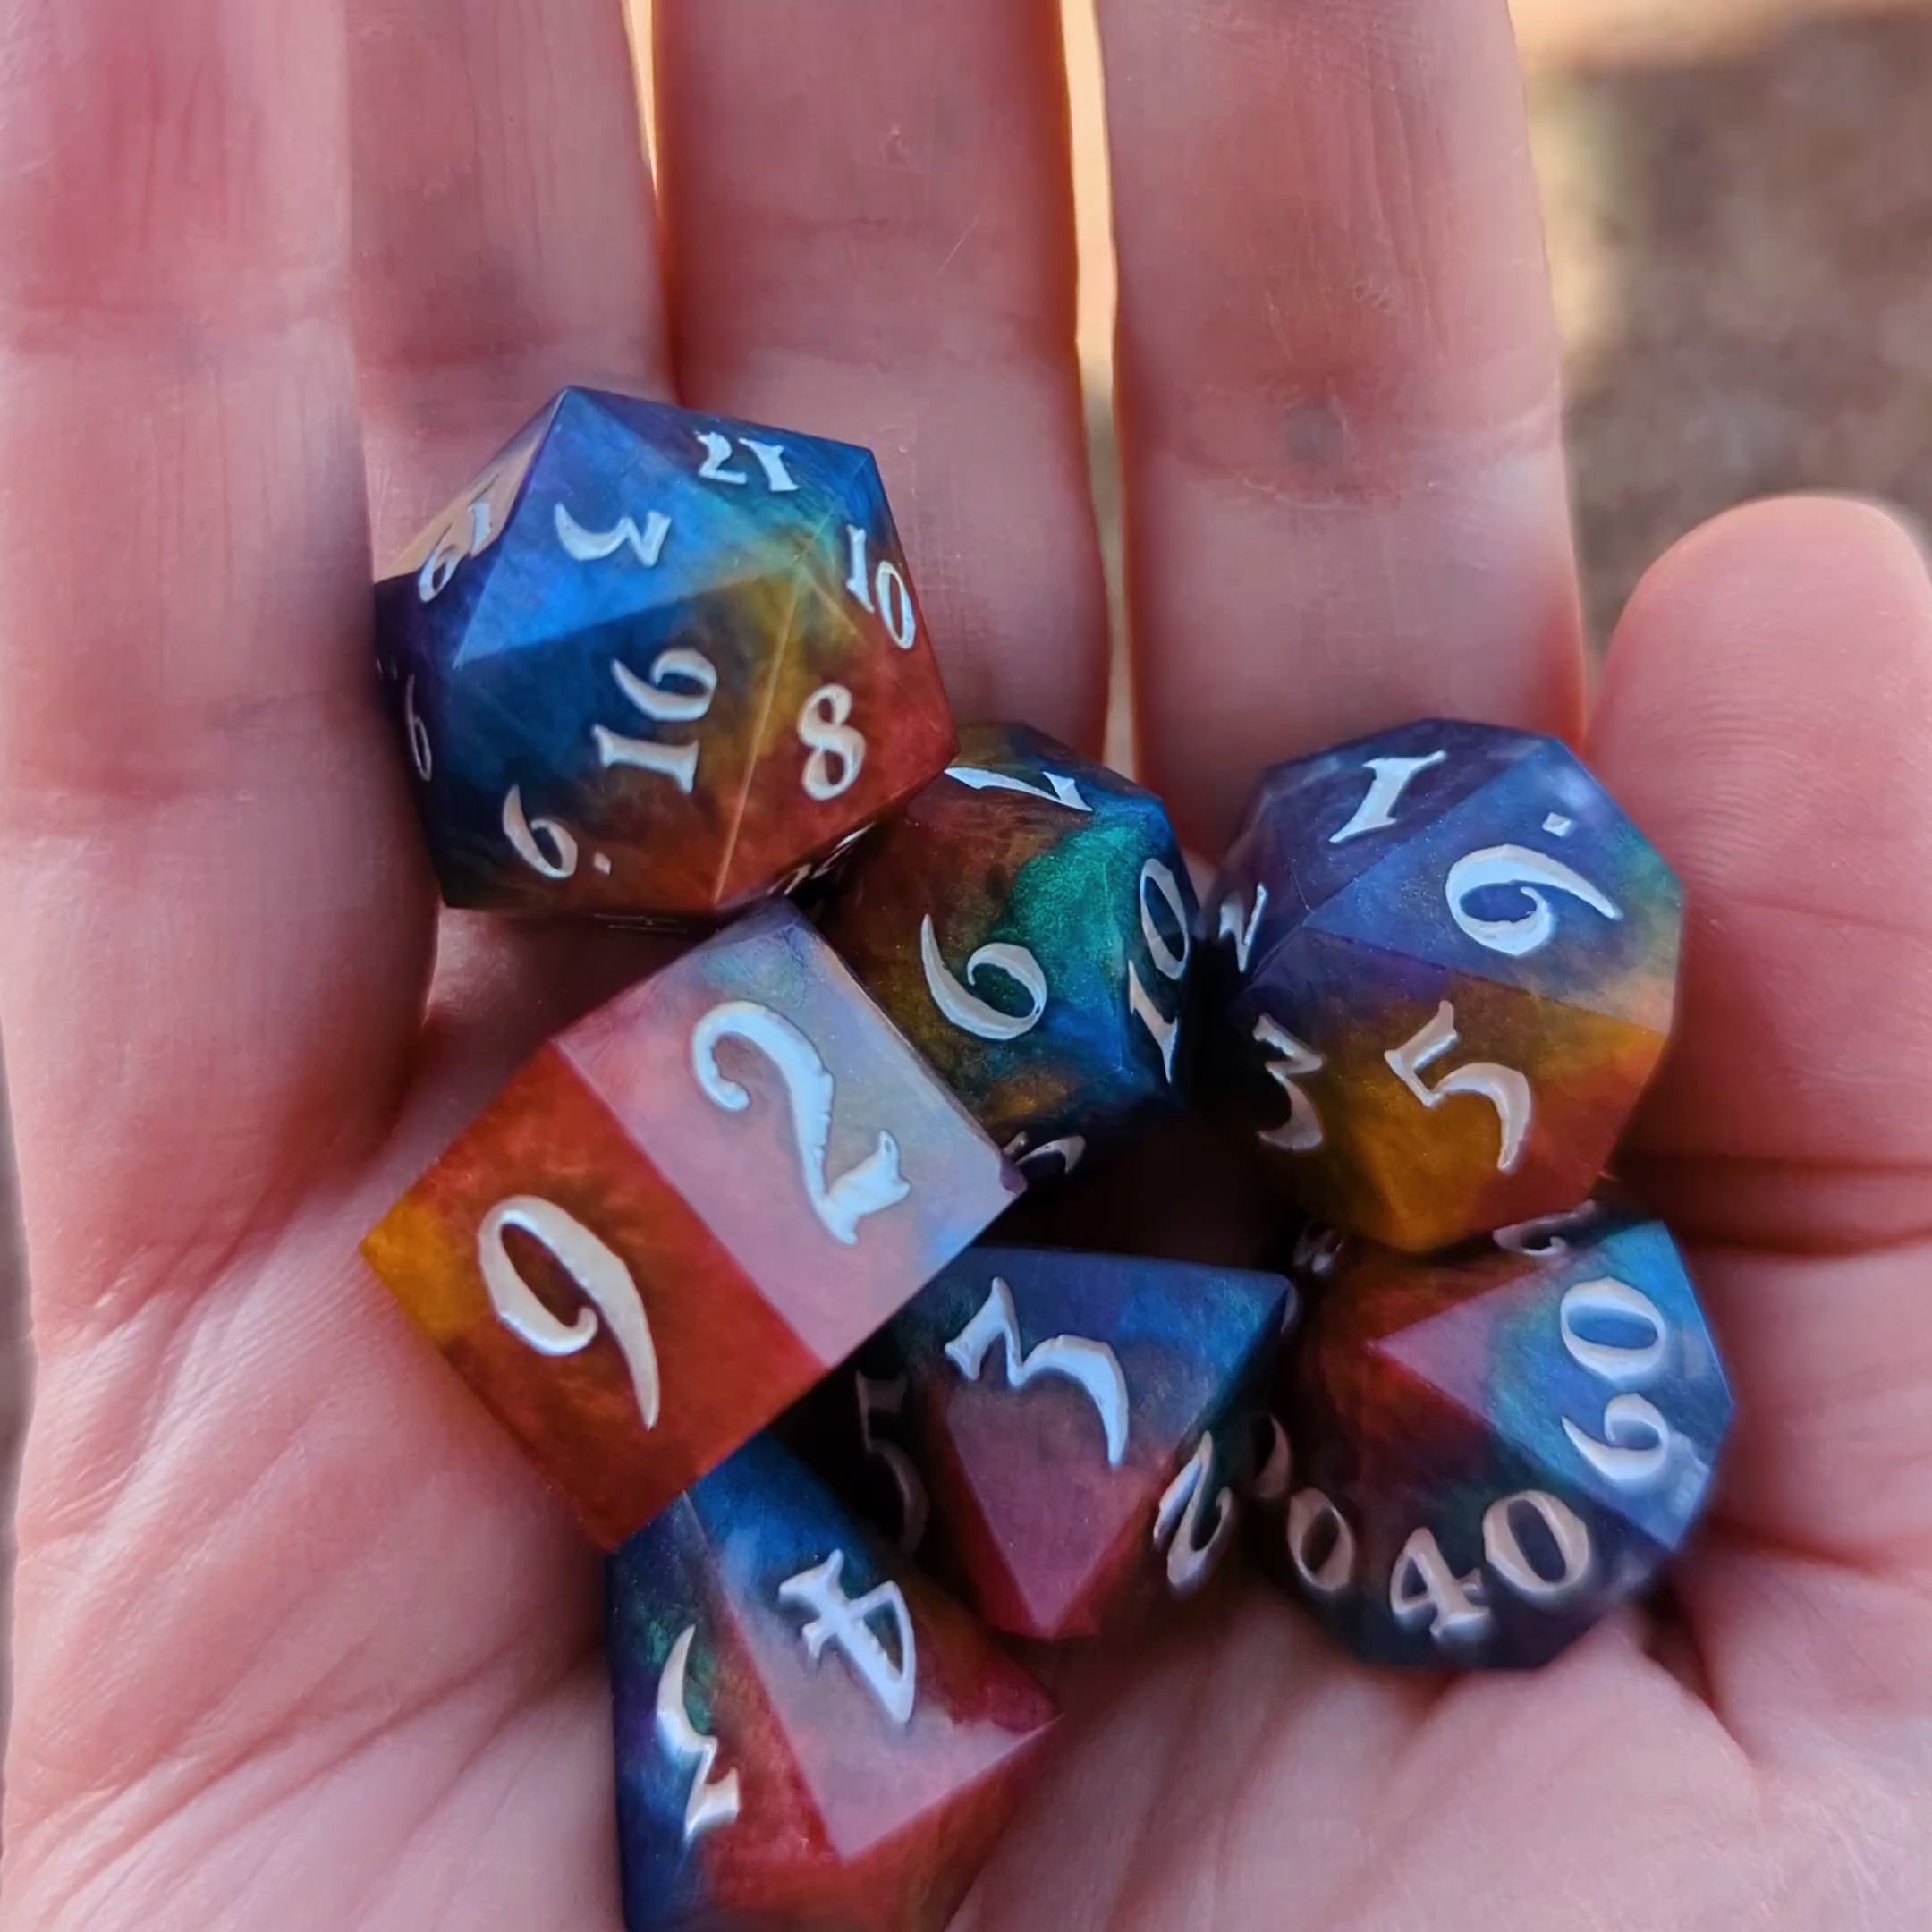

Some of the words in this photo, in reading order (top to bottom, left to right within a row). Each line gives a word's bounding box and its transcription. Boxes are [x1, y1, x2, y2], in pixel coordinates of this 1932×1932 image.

[554, 503, 672, 567] 3
[846, 524, 915, 649] 10
[591, 648, 718, 794] 16
[798, 683, 867, 801] 8
[1329, 751, 1447, 843] 1
[1128, 858, 1191, 1083] 10
[691, 1000, 911, 1245] 2
[1252, 1013, 1326, 1151] 3
[1383, 1000, 1533, 1173] 5
[944, 1275, 1130, 1469] 3
[779, 1548, 918, 1724] 4
[1389, 1488, 1592, 1644] 40
